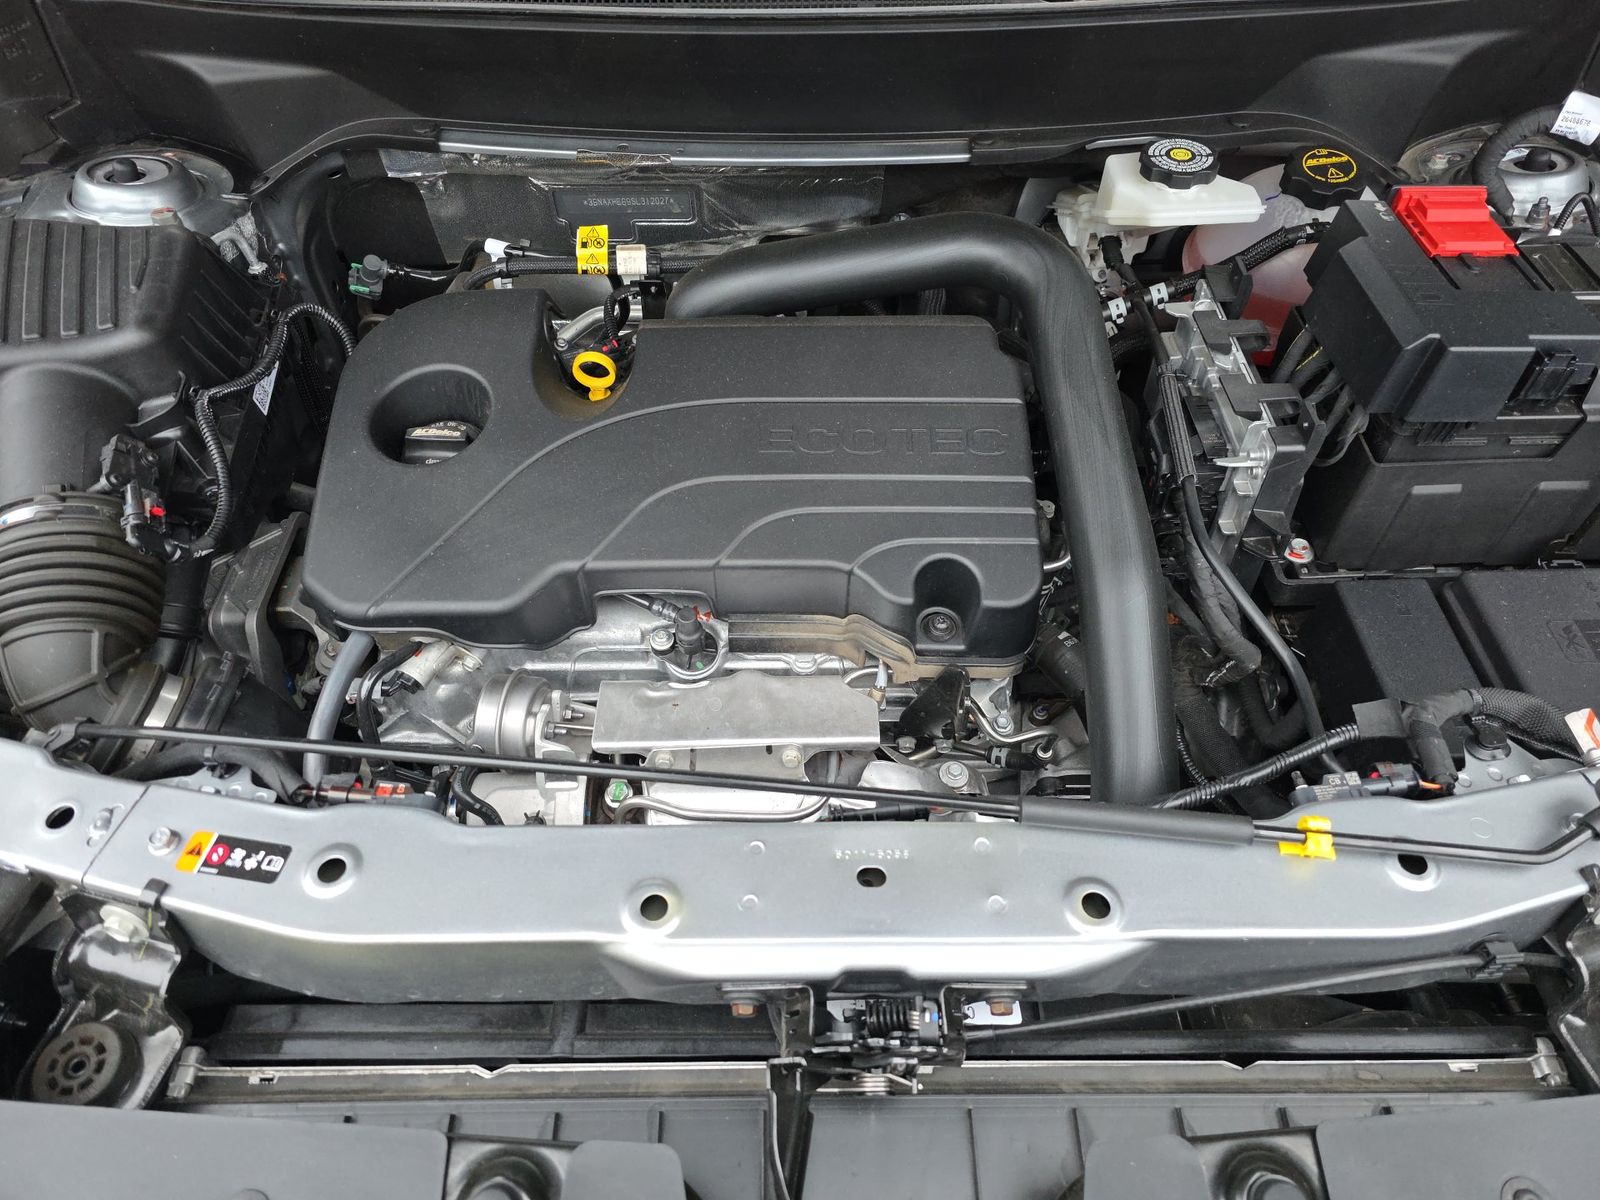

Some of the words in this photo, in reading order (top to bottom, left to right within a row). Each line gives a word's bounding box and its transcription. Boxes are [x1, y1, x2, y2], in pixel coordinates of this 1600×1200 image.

[1306, 156, 1349, 167] ACDelco
[410, 428, 461, 437] ACDelco
[757, 428, 1009, 456] ECOTEC
